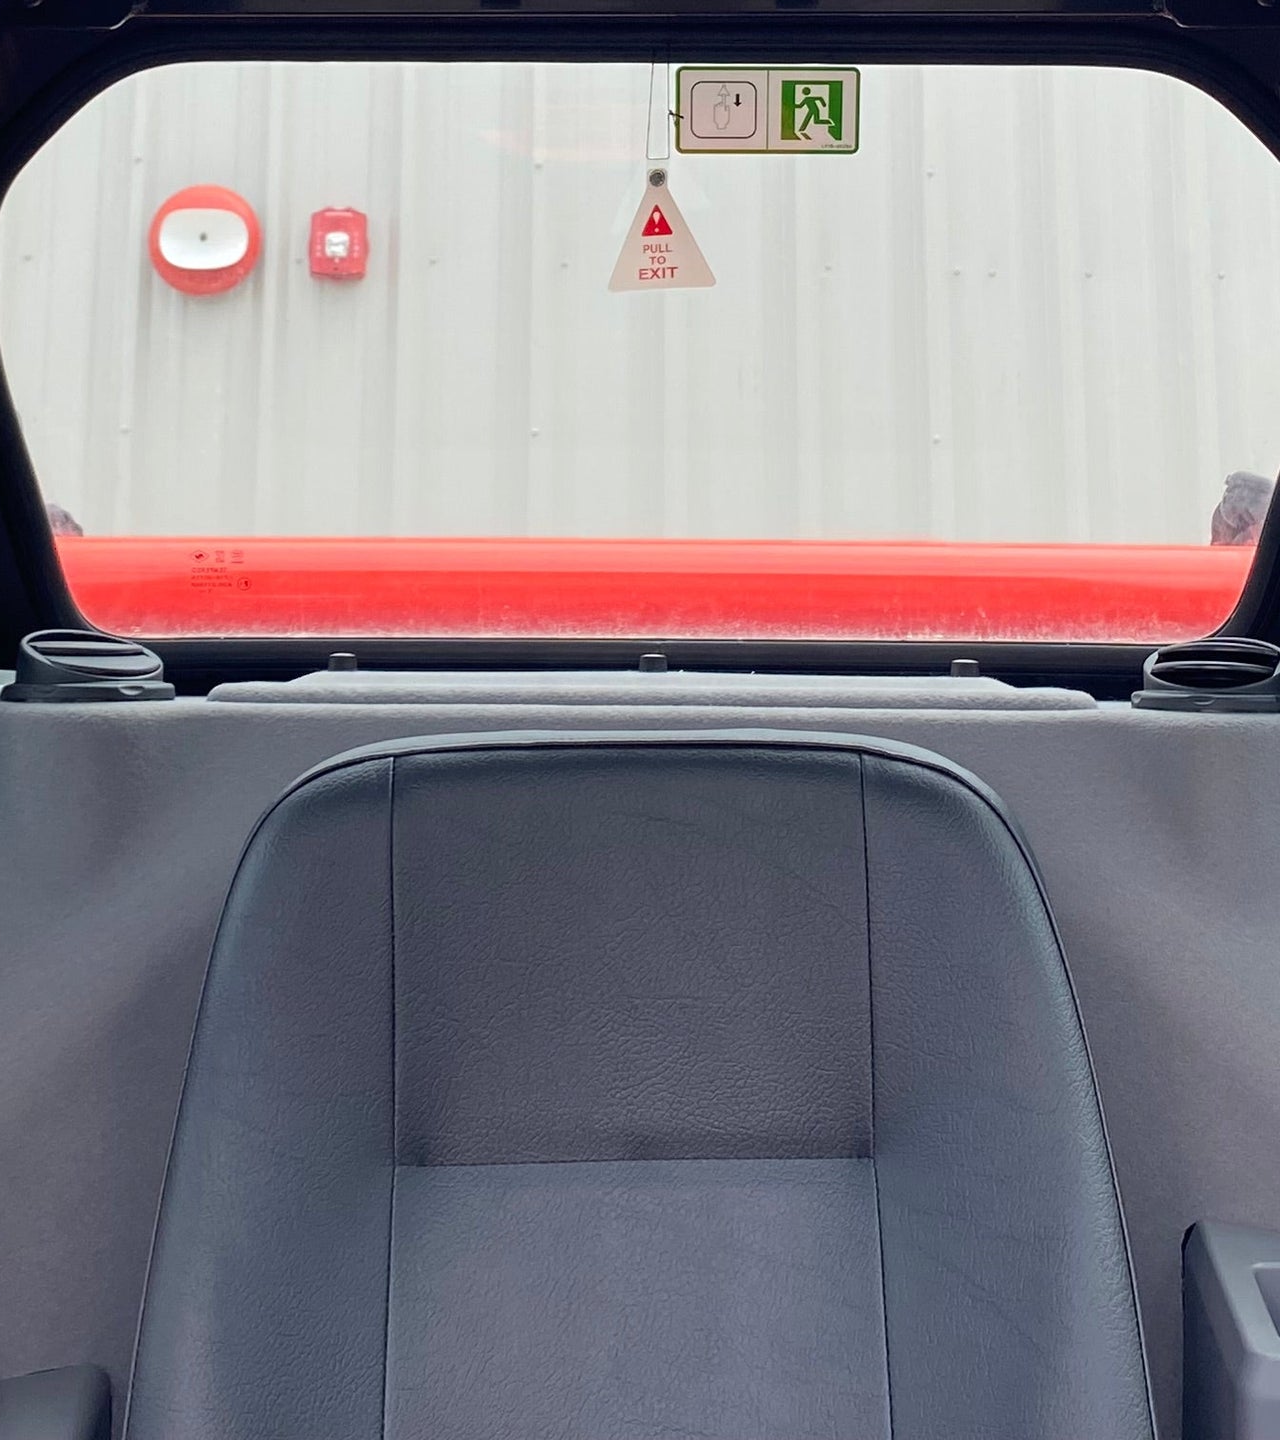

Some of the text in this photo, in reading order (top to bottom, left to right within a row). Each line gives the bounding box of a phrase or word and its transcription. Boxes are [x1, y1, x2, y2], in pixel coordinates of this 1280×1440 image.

[642, 243, 673, 254] PULL
[649, 255, 666, 266] TO
[638, 266, 679, 281] EXIT
